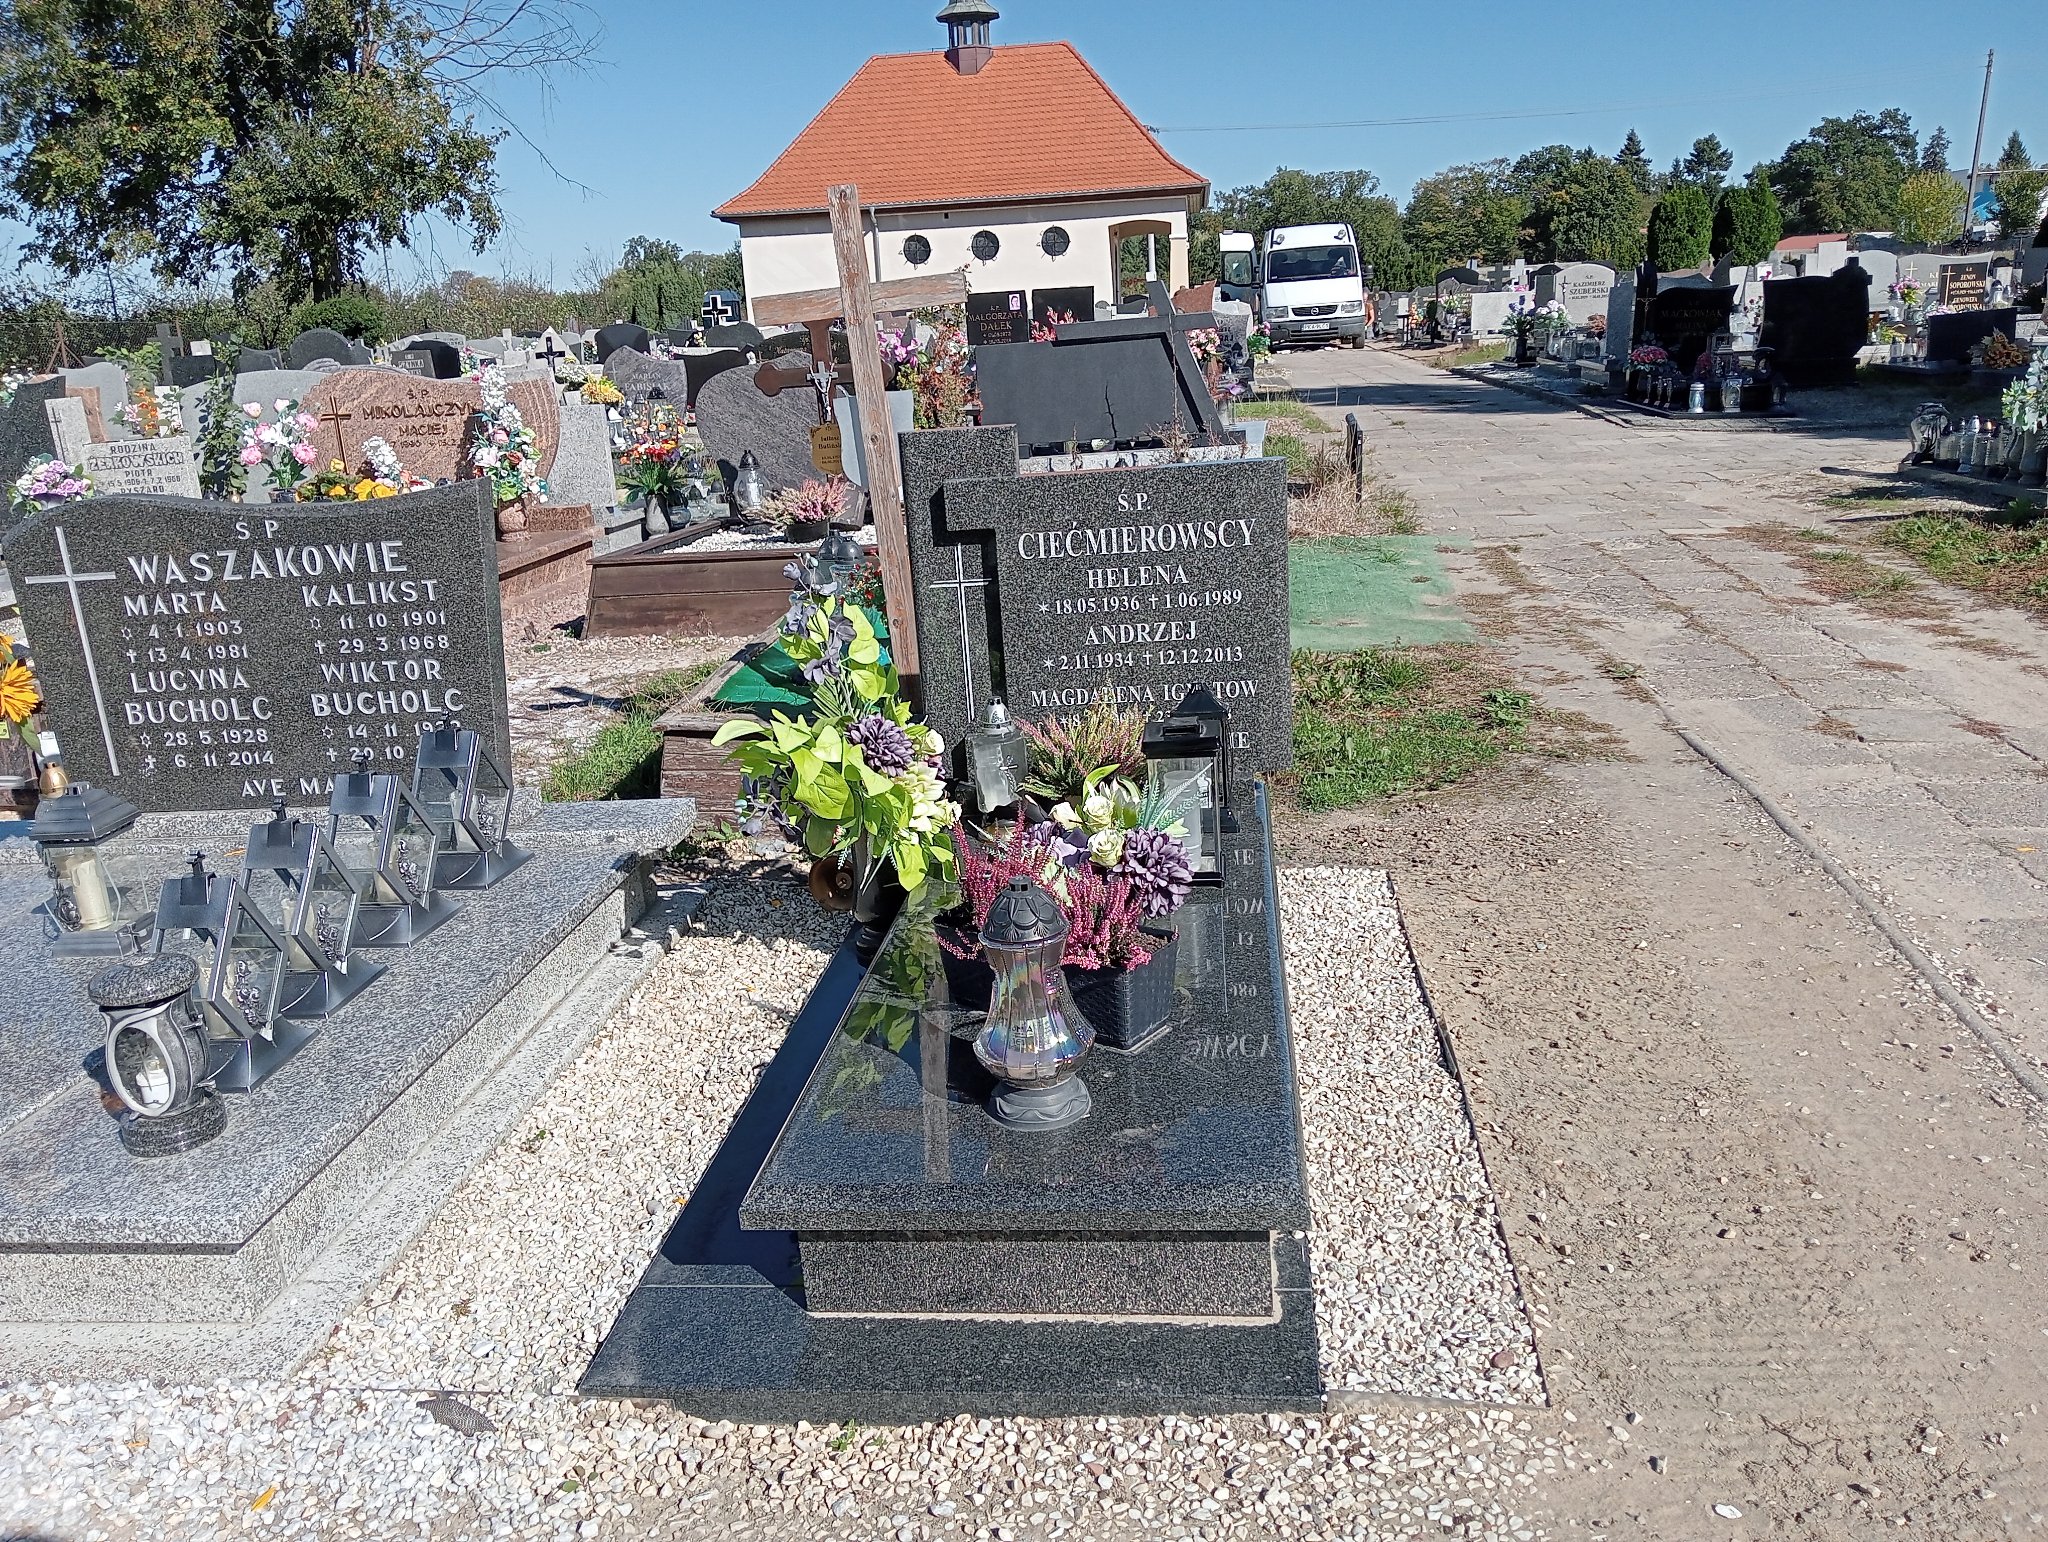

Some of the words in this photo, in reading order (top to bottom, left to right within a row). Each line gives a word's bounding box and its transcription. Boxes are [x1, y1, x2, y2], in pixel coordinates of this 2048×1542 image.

[399, 422, 448, 437] MACIEJ
[110, 443, 157, 454] RODZINA
[124, 468, 153, 478] PIOTR
[1017, 518, 1257, 560] CIEĆMIEROWSCY
[126, 540, 408, 585] WASZAKOWIE
[1086, 564, 1190, 589] HELENA
[123, 590, 229, 617] MARTA
[301, 578, 438, 608] KALIKST
[1083, 620, 1198, 646] ANDRZEJ
[129, 666, 250, 694] LUCYNA
[320, 658, 443, 684] WIKTOR
[124, 695, 273, 725] BUCHOLC
[310, 687, 464, 717] BUCHOLC
[241, 778, 287, 797] AVE
